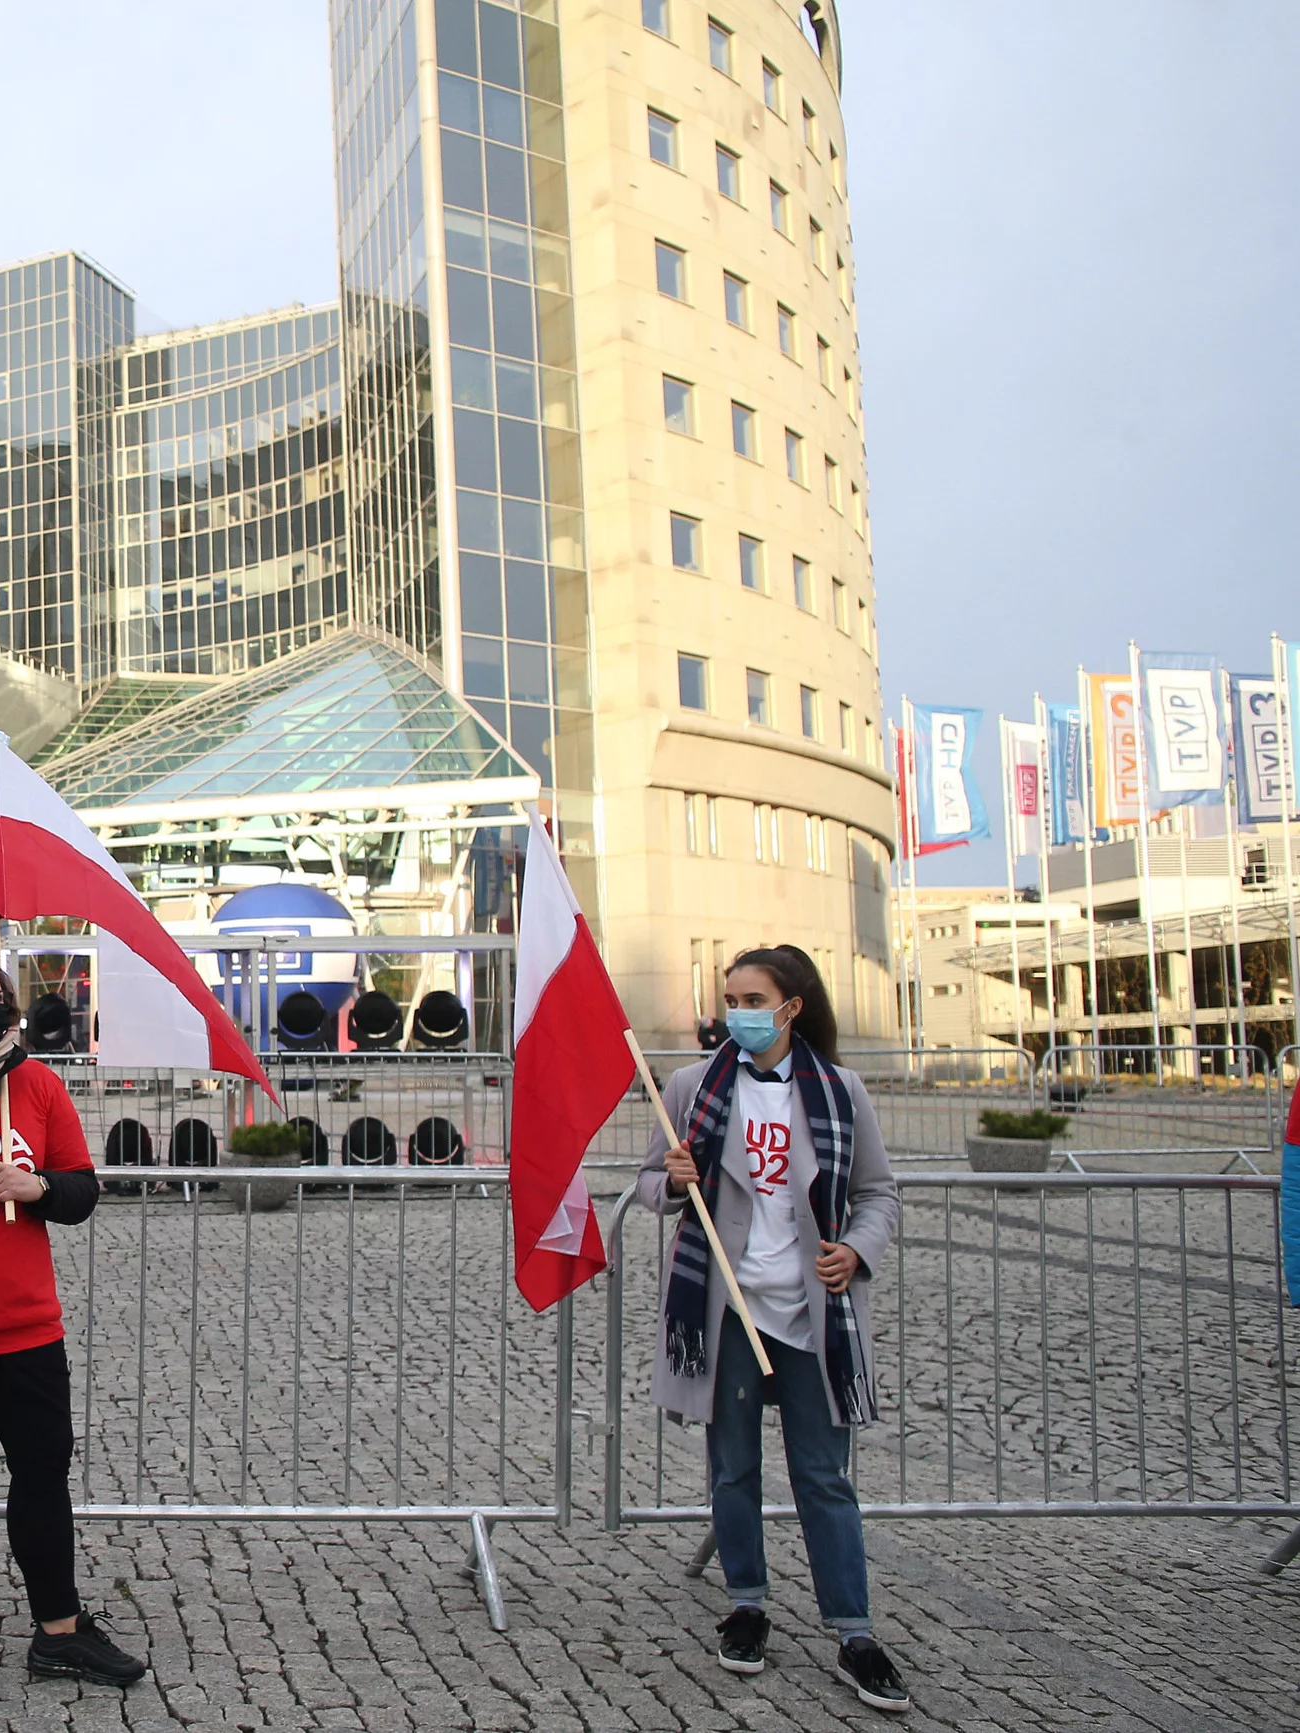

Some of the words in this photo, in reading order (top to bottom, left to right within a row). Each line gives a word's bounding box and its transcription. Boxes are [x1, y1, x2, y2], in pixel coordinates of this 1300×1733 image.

[1169, 694, 1202, 767] TVP
[1250, 692, 1286, 717] 3
[940, 722, 958, 769] HD
[1121, 732, 1139, 799] TVP
[1261, 730, 1291, 796] TVP
[943, 780, 959, 820] TVP
